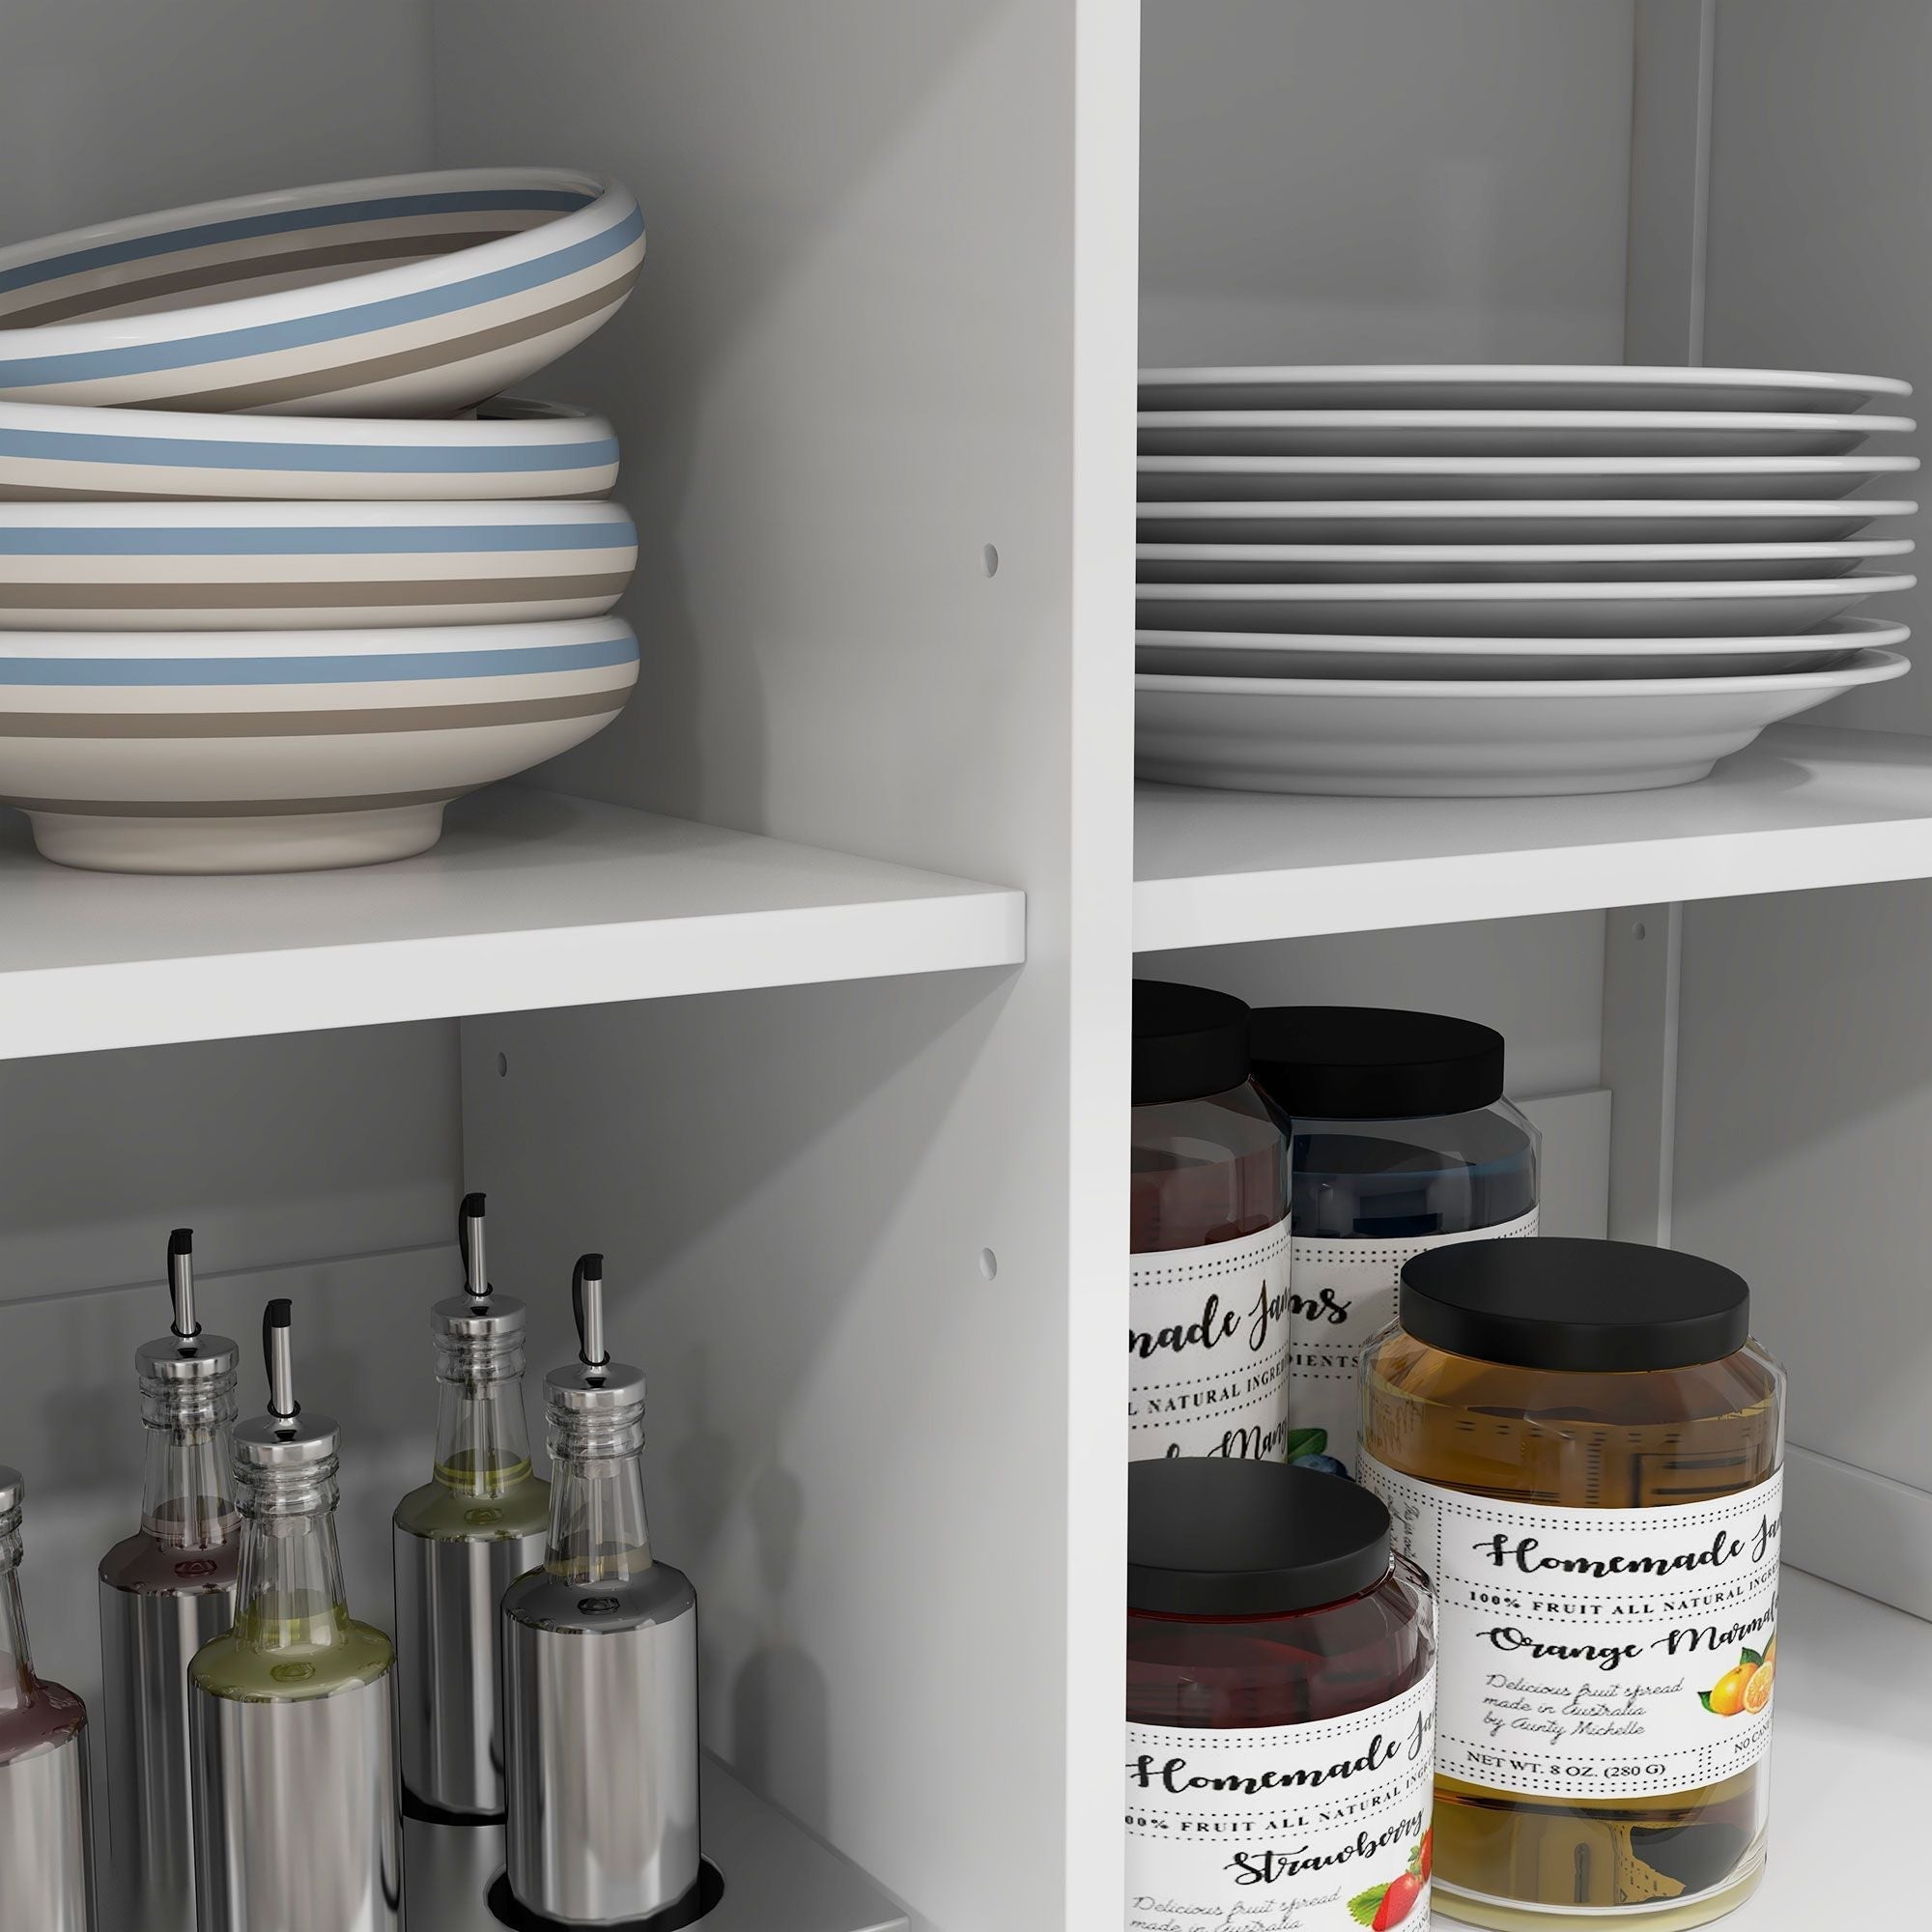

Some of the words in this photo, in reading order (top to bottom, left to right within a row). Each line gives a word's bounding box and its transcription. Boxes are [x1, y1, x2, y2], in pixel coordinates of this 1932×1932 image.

[1148, 1383, 1240, 1413] NATURAL
[1472, 1530, 1746, 1578] Homemade
[1751, 1514, 1781, 1563] Ja
[1469, 1591, 1521, 1609] 100%
[1532, 1601, 1603, 1615] FRUIT
[1611, 1605, 1655, 1615] ALL
[1663, 1586, 1745, 1612] NATURAL
[1476, 1627, 1643, 1671] Orange
[1483, 1697, 1533, 1712] made
[1537, 1703, 1556, 1715] in
[1561, 1700, 1646, 1717] Australia
[1486, 1674, 1572, 1697] Delicious
[1573, 1683, 1621, 1706] fruit
[1623, 1677, 1685, 1708] spread
[1483, 1711, 1507, 1737] by
[1511, 1717, 1568, 1746] Aunty
[1570, 1719, 1646, 1737] Michelle
[1734, 1738, 1750, 1754] NO
[1125, 1734, 1402, 1795] Homemade
[1407, 1711, 1434, 1760] Ja
[1466, 1750, 1507, 1769] NET
[1509, 1759, 1546, 1776] WT.
[1549, 1765, 1561, 1776] 8
[1565, 1766, 1599, 1778] OZ.
[1603, 1766, 1641, 1779] (280
[1644, 1764, 1666, 1776] G)
[1180, 1821, 1256, 1833] FRUIT
[1264, 1816, 1310, 1831] ALL
[1319, 1787, 1402, 1822] NATURAL
[1223, 1808, 1424, 1886] Strawberry
[1131, 1896, 1224, 1916] Delicious
[1225, 1899, 1276, 1923] fruit
[1280, 1886, 1342, 1922] spread
